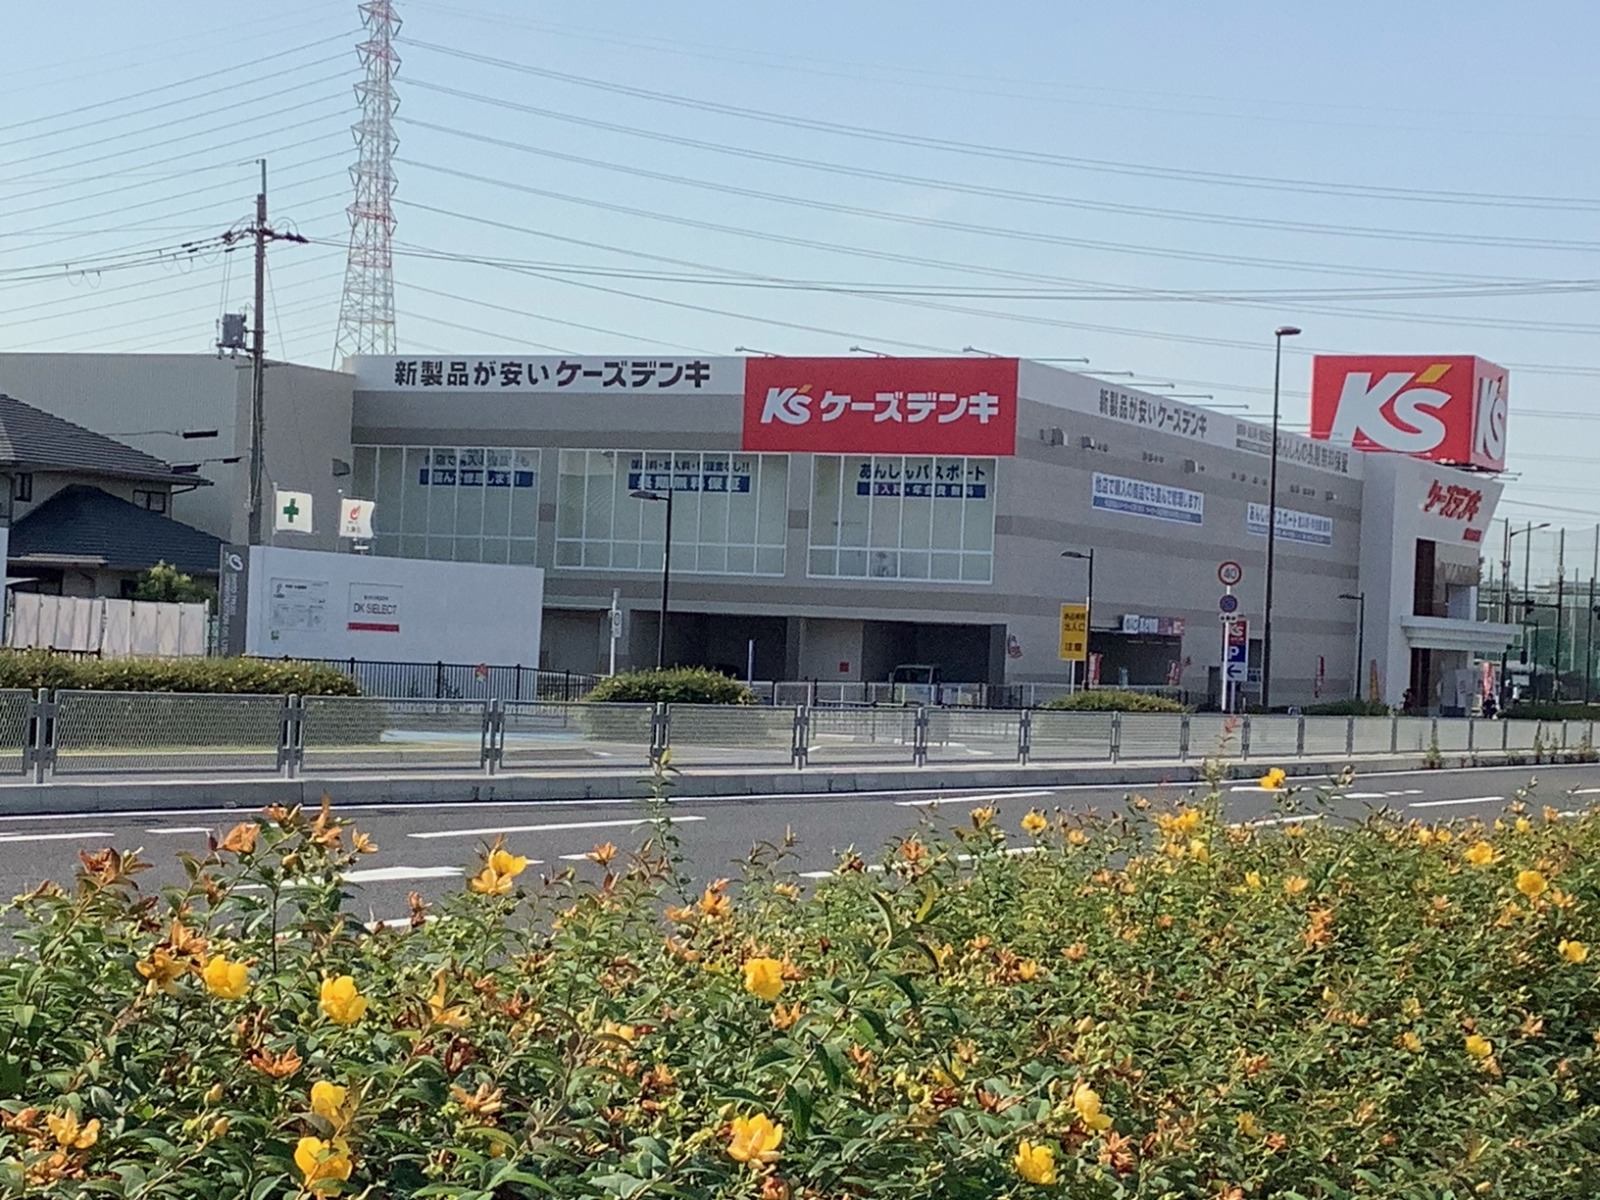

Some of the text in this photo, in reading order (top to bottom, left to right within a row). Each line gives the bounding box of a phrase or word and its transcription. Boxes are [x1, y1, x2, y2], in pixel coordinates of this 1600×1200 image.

[394, 360, 710, 388] 新製品が安いケーズデンキ
[820, 390, 999, 424] ケーズデンキ
[366, 603, 398, 614] SELECT
